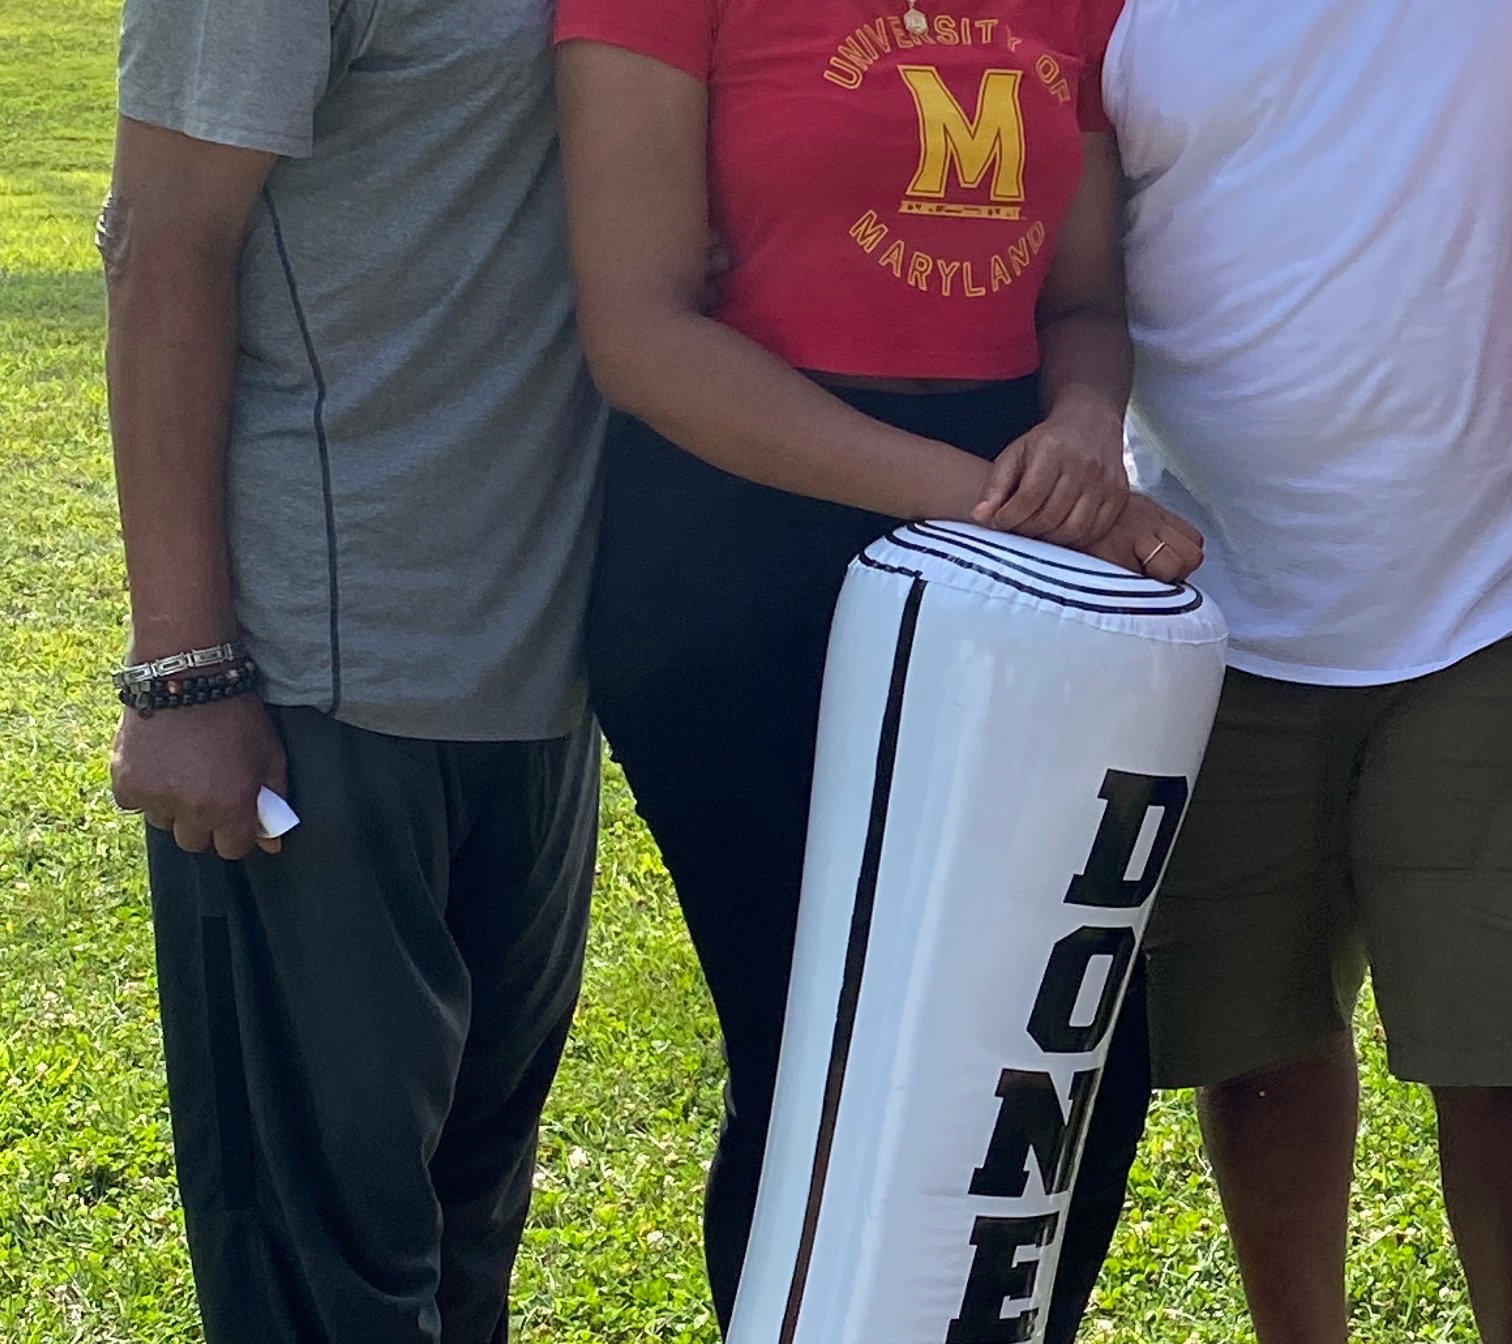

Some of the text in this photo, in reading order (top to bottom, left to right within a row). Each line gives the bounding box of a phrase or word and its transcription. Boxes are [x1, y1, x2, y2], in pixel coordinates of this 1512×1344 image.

[1035, 54, 1071, 104] OF
[897, 64, 1026, 202] M
[849, 209, 1046, 297] MARYLAND
